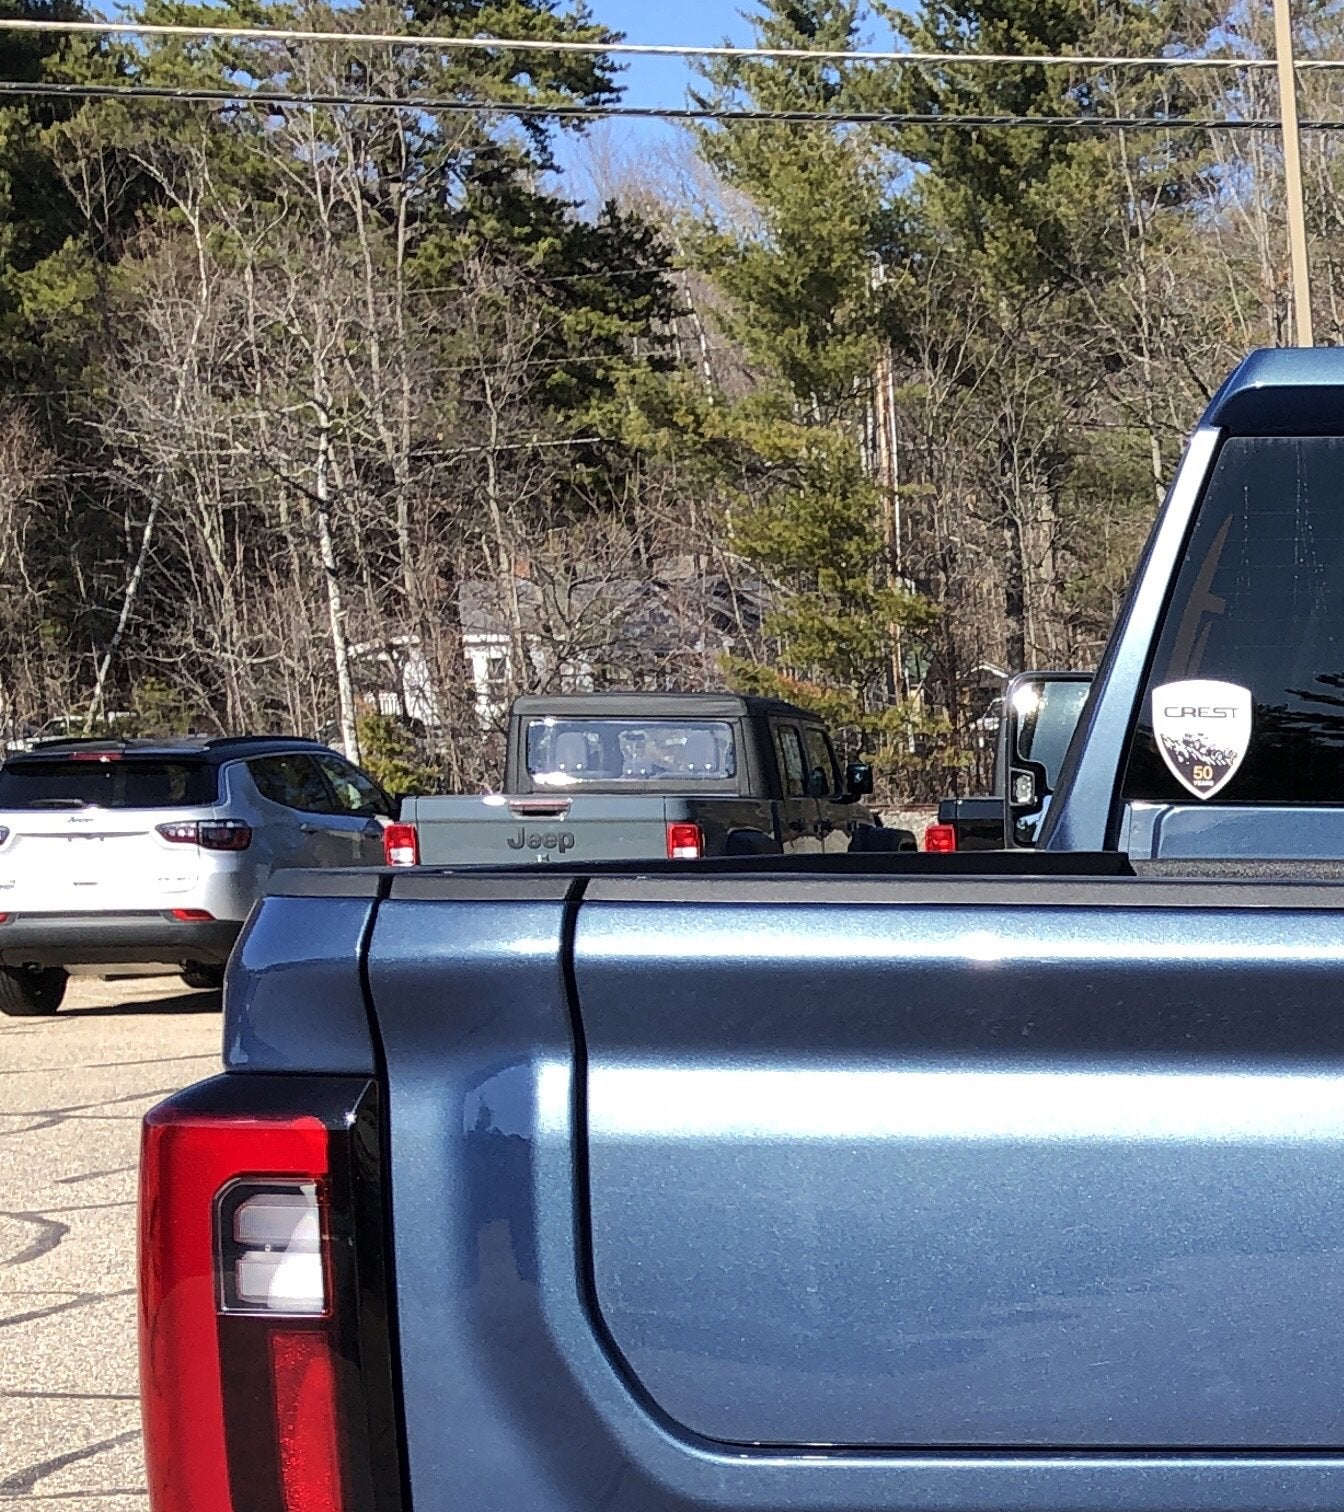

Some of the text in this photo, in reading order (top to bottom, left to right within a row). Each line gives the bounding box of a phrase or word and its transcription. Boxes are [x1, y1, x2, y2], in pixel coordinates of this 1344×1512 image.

[1164, 706, 1238, 718] CREST
[1193, 765, 1213, 780] 50
[507, 827, 575, 853] Jeep
